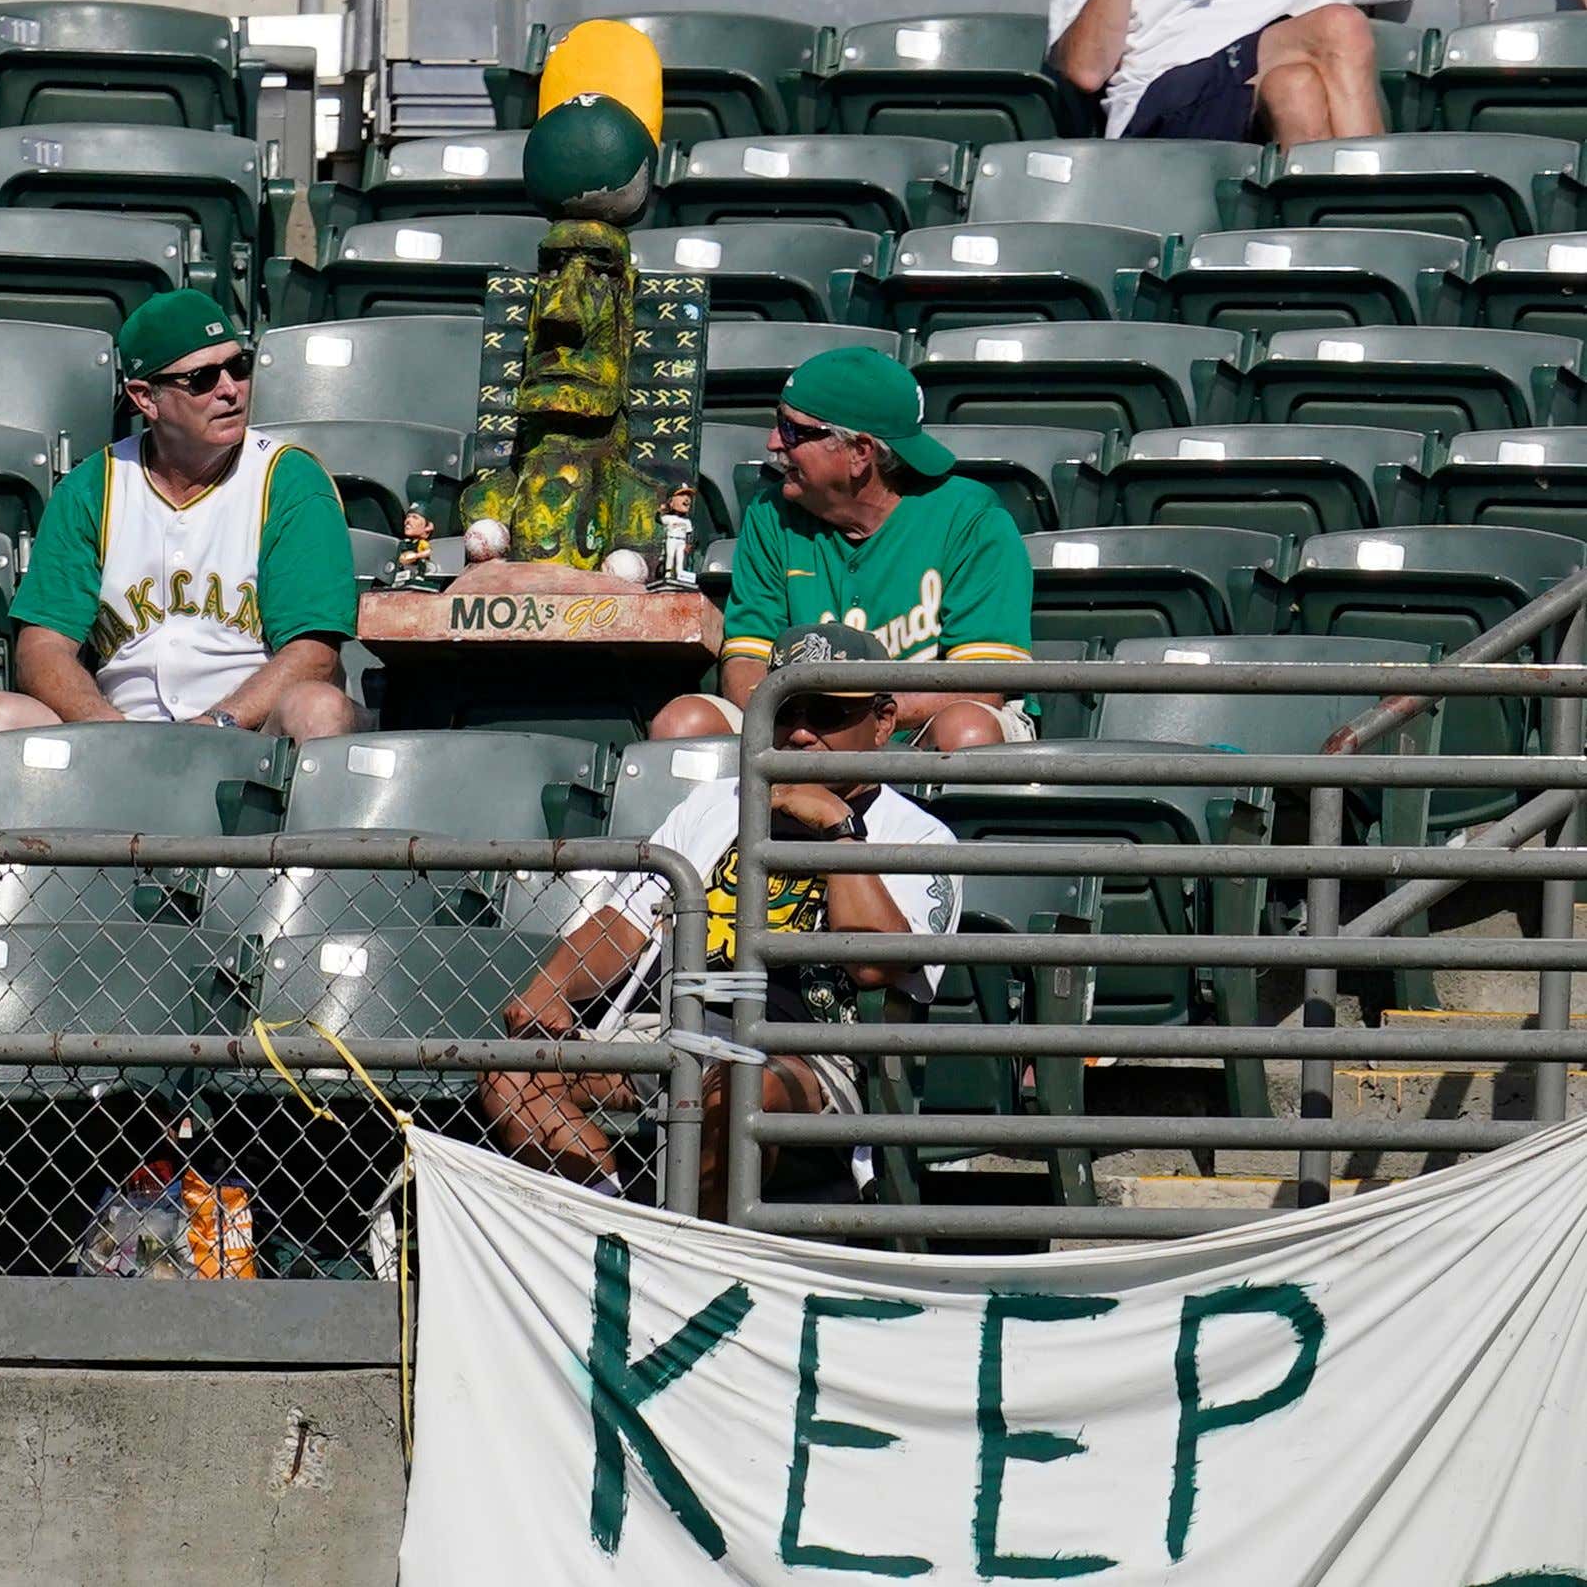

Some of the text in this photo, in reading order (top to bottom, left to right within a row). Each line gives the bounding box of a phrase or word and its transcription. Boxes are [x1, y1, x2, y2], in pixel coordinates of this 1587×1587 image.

[10, 20, 26, 43] 11
[33, 141, 48, 164] 11
[564, 596, 620, 637] GO
[588, 1231, 1327, 1579] KEEP
